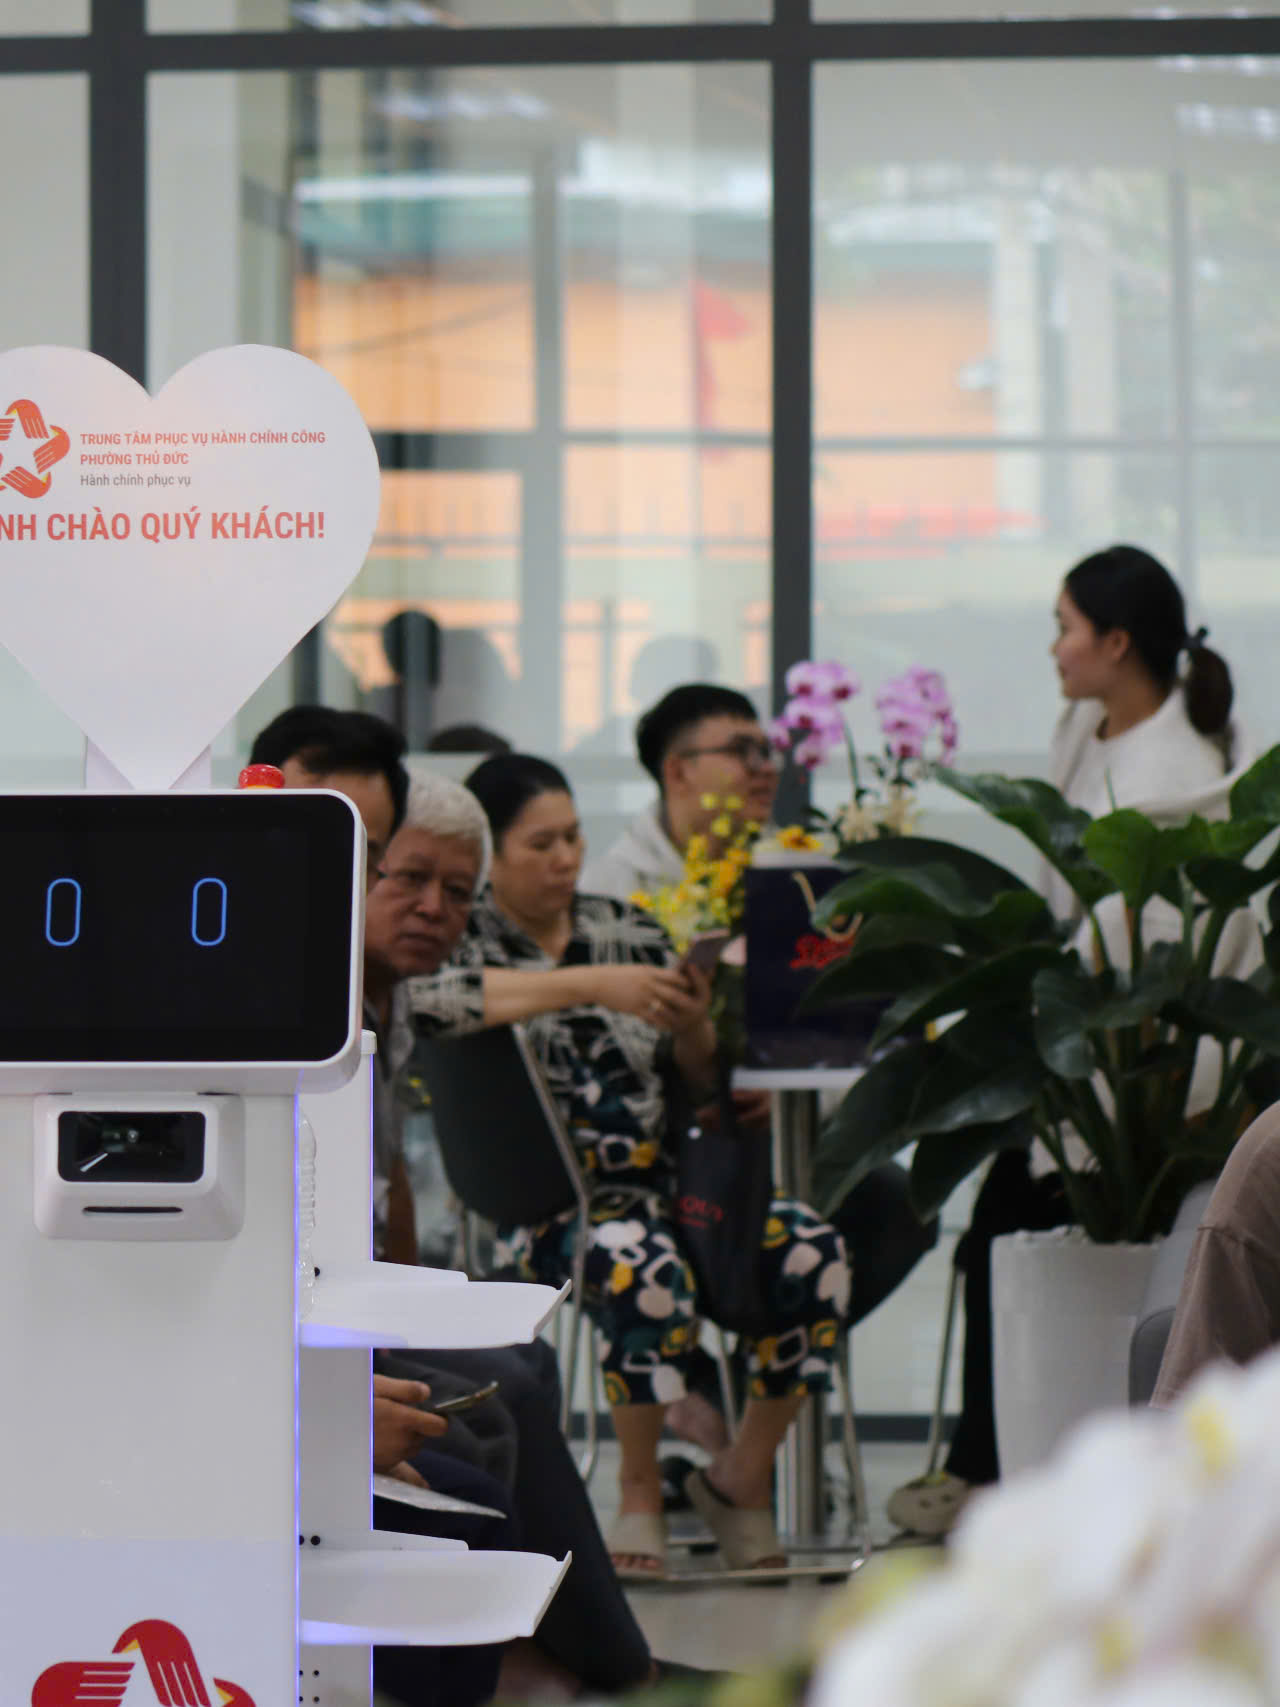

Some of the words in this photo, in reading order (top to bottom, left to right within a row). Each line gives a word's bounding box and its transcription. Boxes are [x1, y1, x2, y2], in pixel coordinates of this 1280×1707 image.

[80, 433, 122, 445] TRUNG
[124, 430, 152, 445] TÂM
[154, 432, 189, 446] PHỤC
[191, 432, 208, 446] VỤ
[211, 429, 247, 444] HÀNH
[250, 429, 289, 444] CHÍNH
[291, 429, 326, 444] CÔNG
[80, 451, 132, 465] PHƯỜNG
[135, 450, 160, 465] THỦ
[162, 451, 190, 465] ĐỨC
[80, 473, 110, 487] Hành
[113, 473, 144, 487] chính
[147, 473, 175, 488] phục
[177, 476, 191, 487] vụ
[47, 506, 131, 541] CHÀO
[141, 505, 202, 544] QUÝ
[211, 504, 325, 541] KHÁCH!
